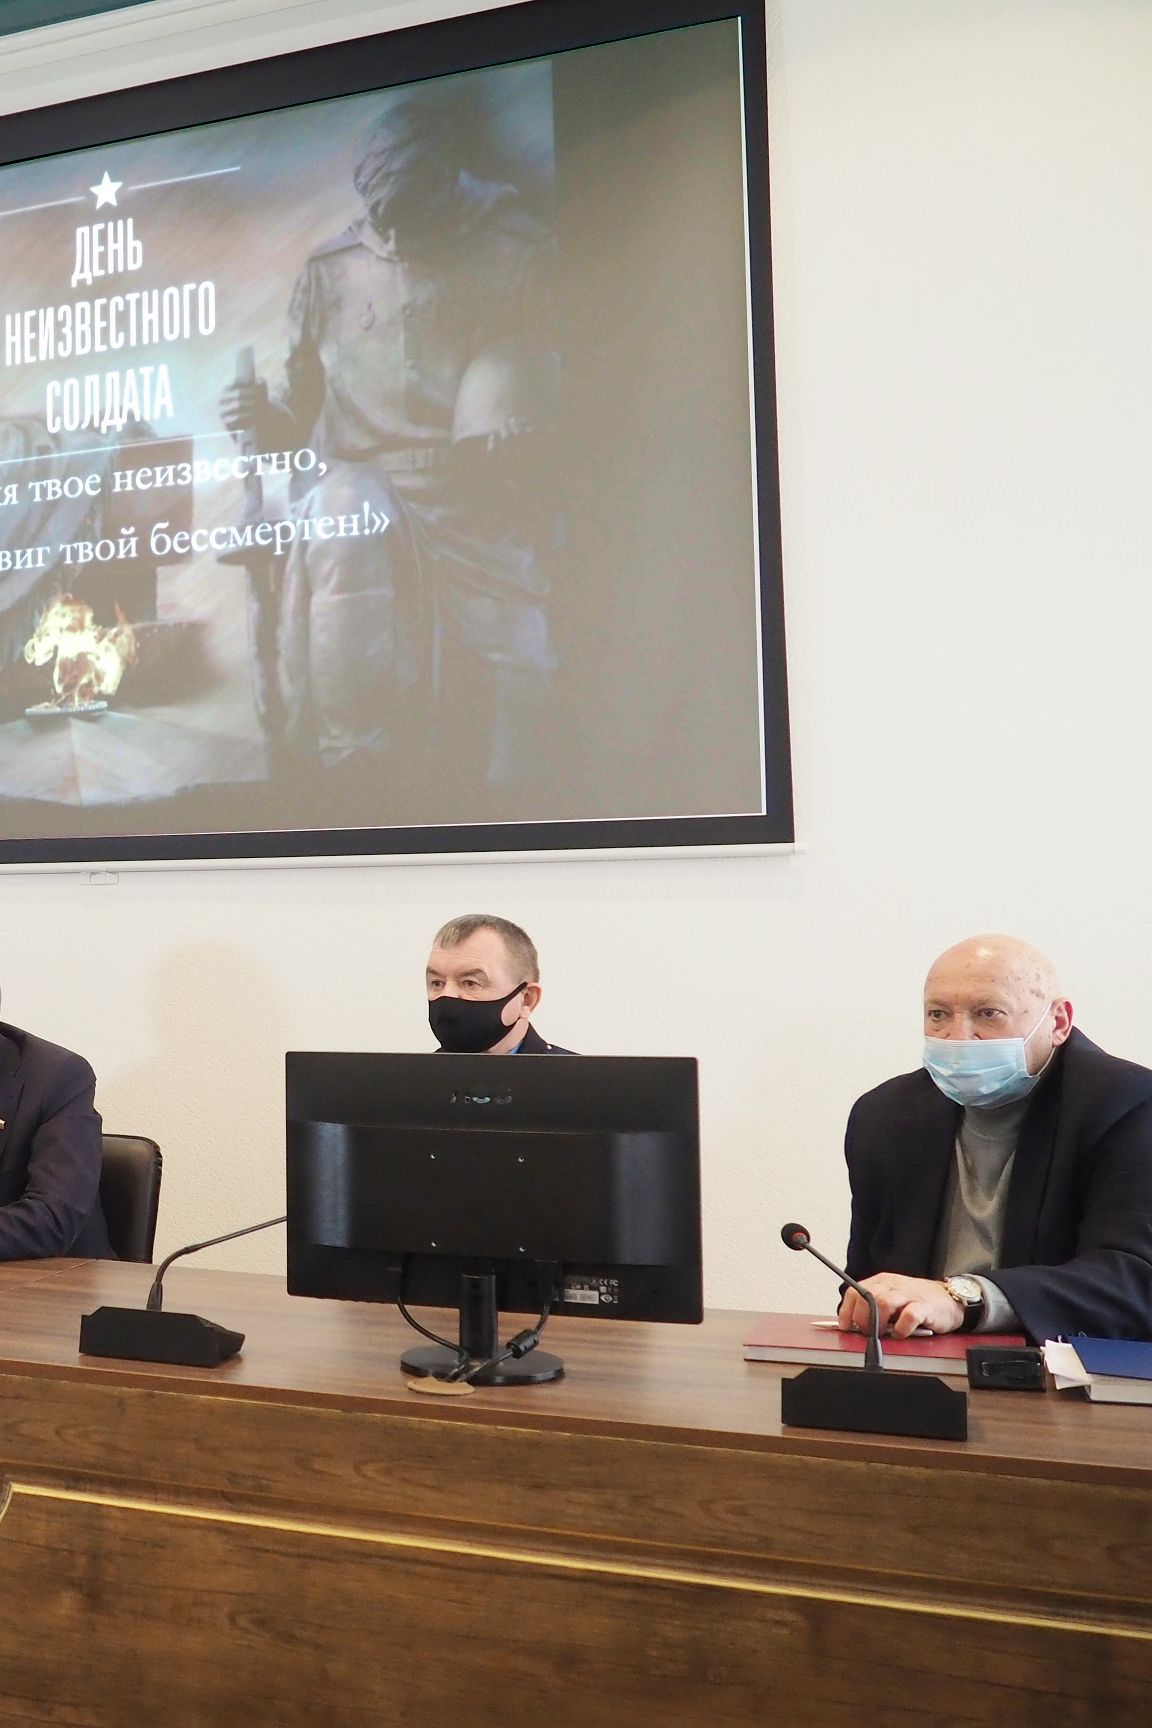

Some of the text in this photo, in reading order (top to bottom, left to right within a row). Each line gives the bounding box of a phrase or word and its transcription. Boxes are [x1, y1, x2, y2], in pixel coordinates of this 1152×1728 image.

[71, 217, 144, 288] ДЕНЬ
[5, 280, 216, 367] НЕИЗВЕСТНОГО
[46, 364, 174, 434] СОЛДАТА
[28, 472, 102, 502] твое
[112, 447, 327, 493] неизвестно,
[59, 526, 139, 566] твой
[150, 501, 391, 556] бессмертен!»
